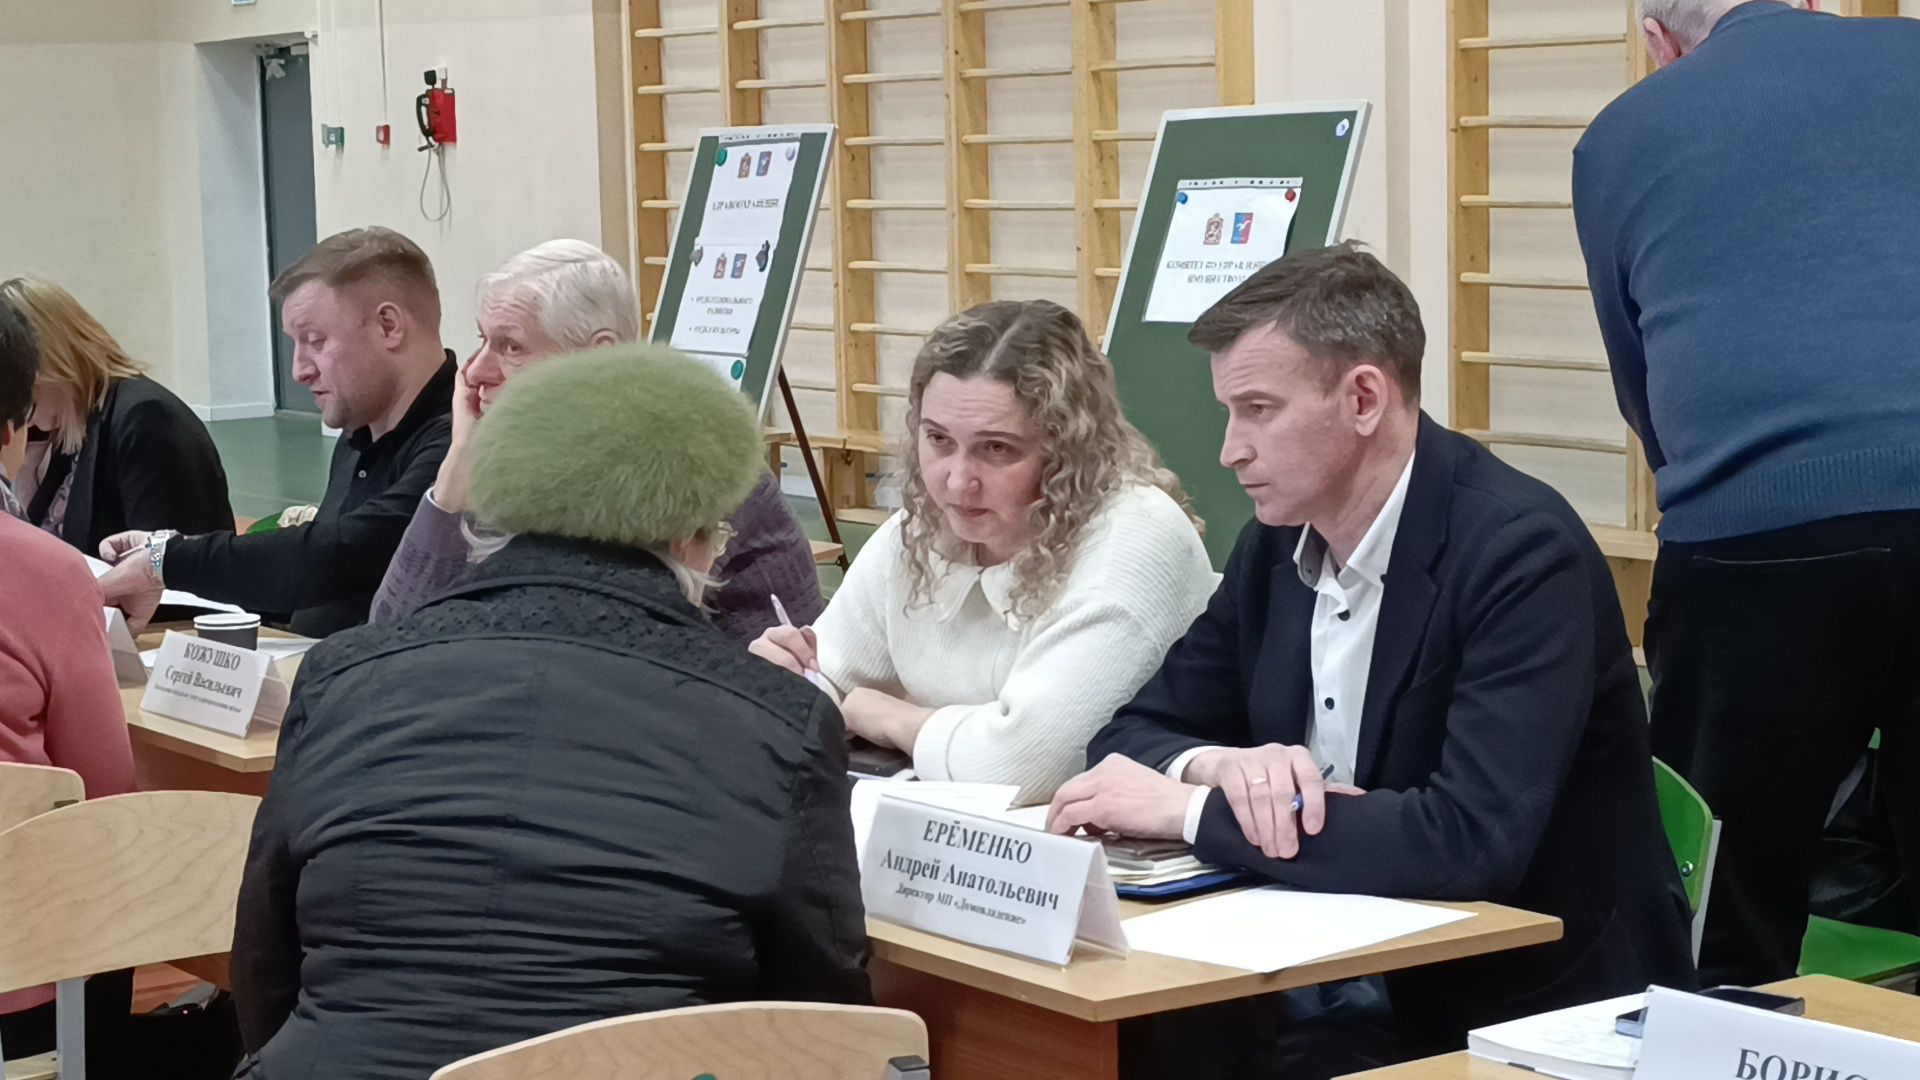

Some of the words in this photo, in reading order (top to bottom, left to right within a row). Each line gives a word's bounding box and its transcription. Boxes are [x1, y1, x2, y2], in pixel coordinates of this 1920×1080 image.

[183, 642, 241, 671] КОЖУШКО
[165, 664, 193, 686] Сергей
[193, 671, 243, 698] Васильевич
[922, 819, 1033, 864] ЕРЁМЕНКО
[880, 848, 940, 881] Андрей
[942, 864, 1059, 911] Анатольевич
[895, 882, 935, 904] Директор
